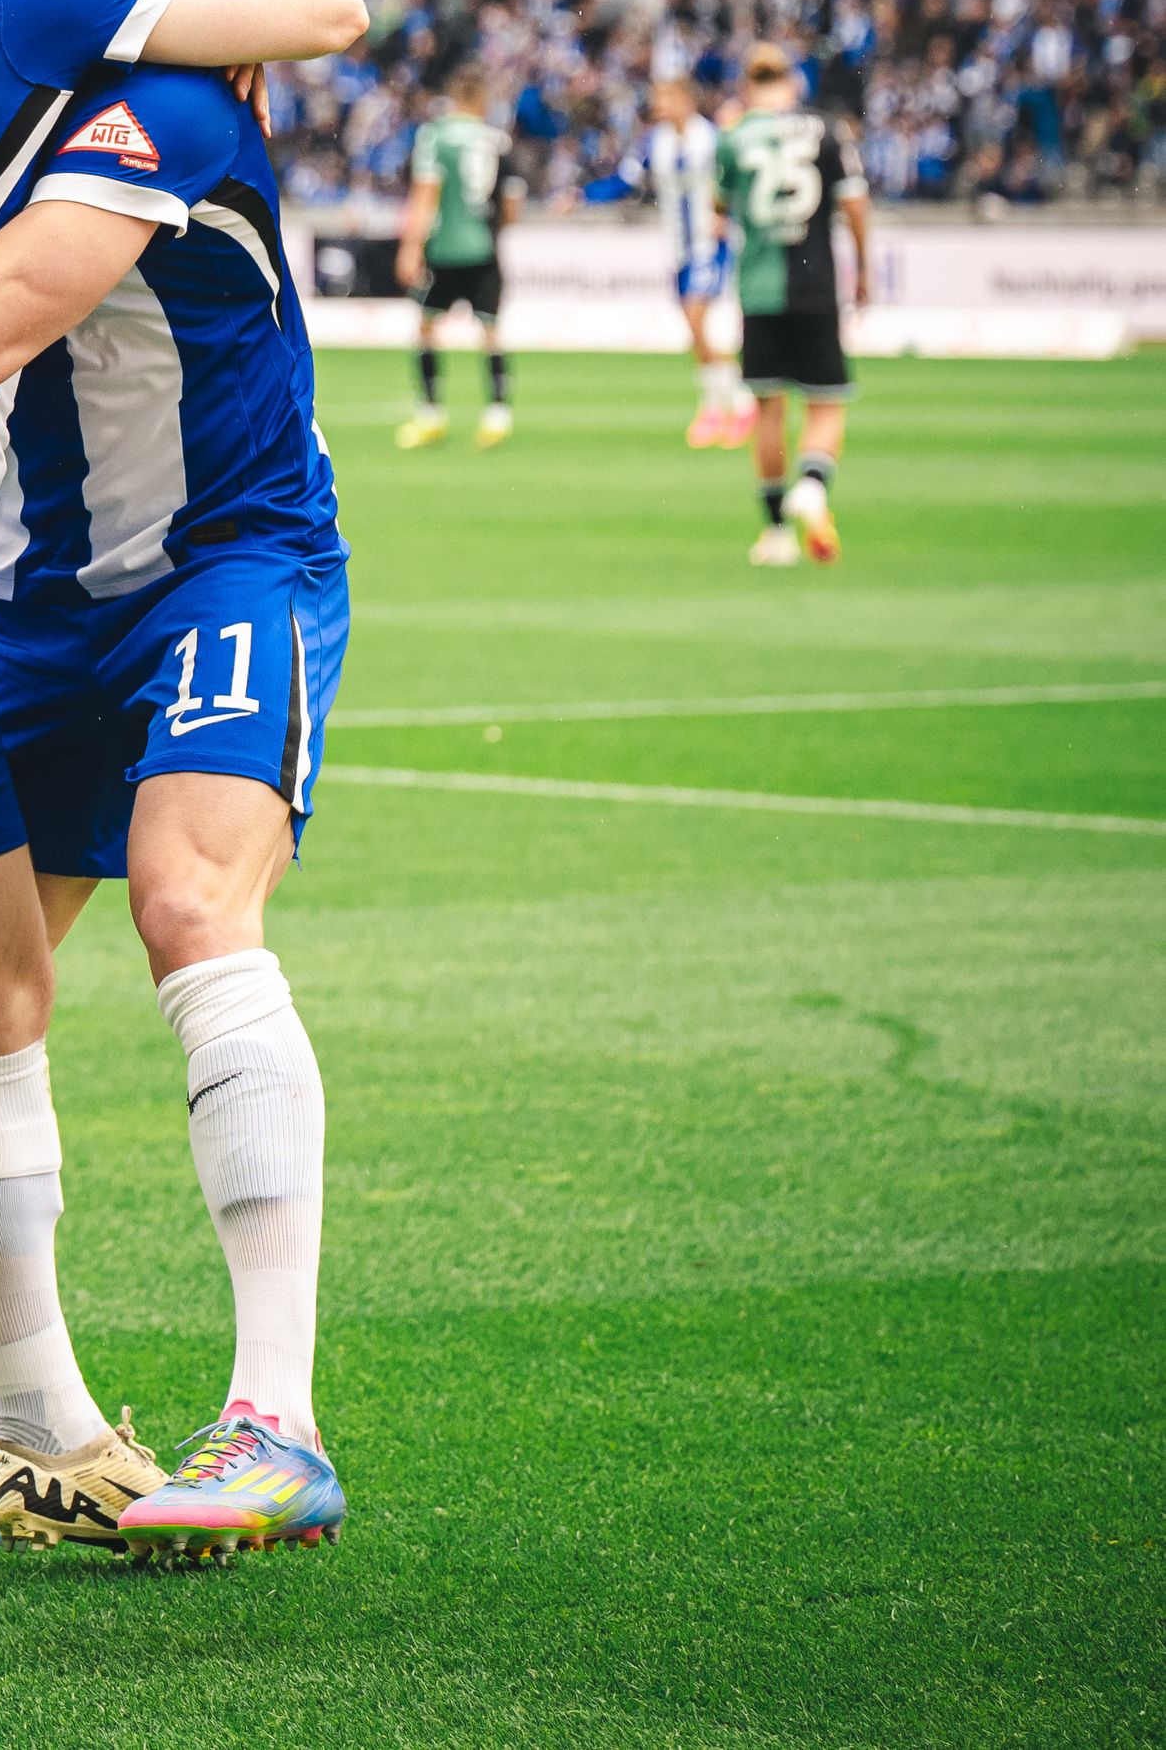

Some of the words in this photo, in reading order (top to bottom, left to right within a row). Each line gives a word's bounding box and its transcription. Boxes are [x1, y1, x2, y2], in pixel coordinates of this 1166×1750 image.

[90, 122, 131, 146] WTG
[128, 157, 157, 169] wtg.com
[165, 621, 260, 719] 11
